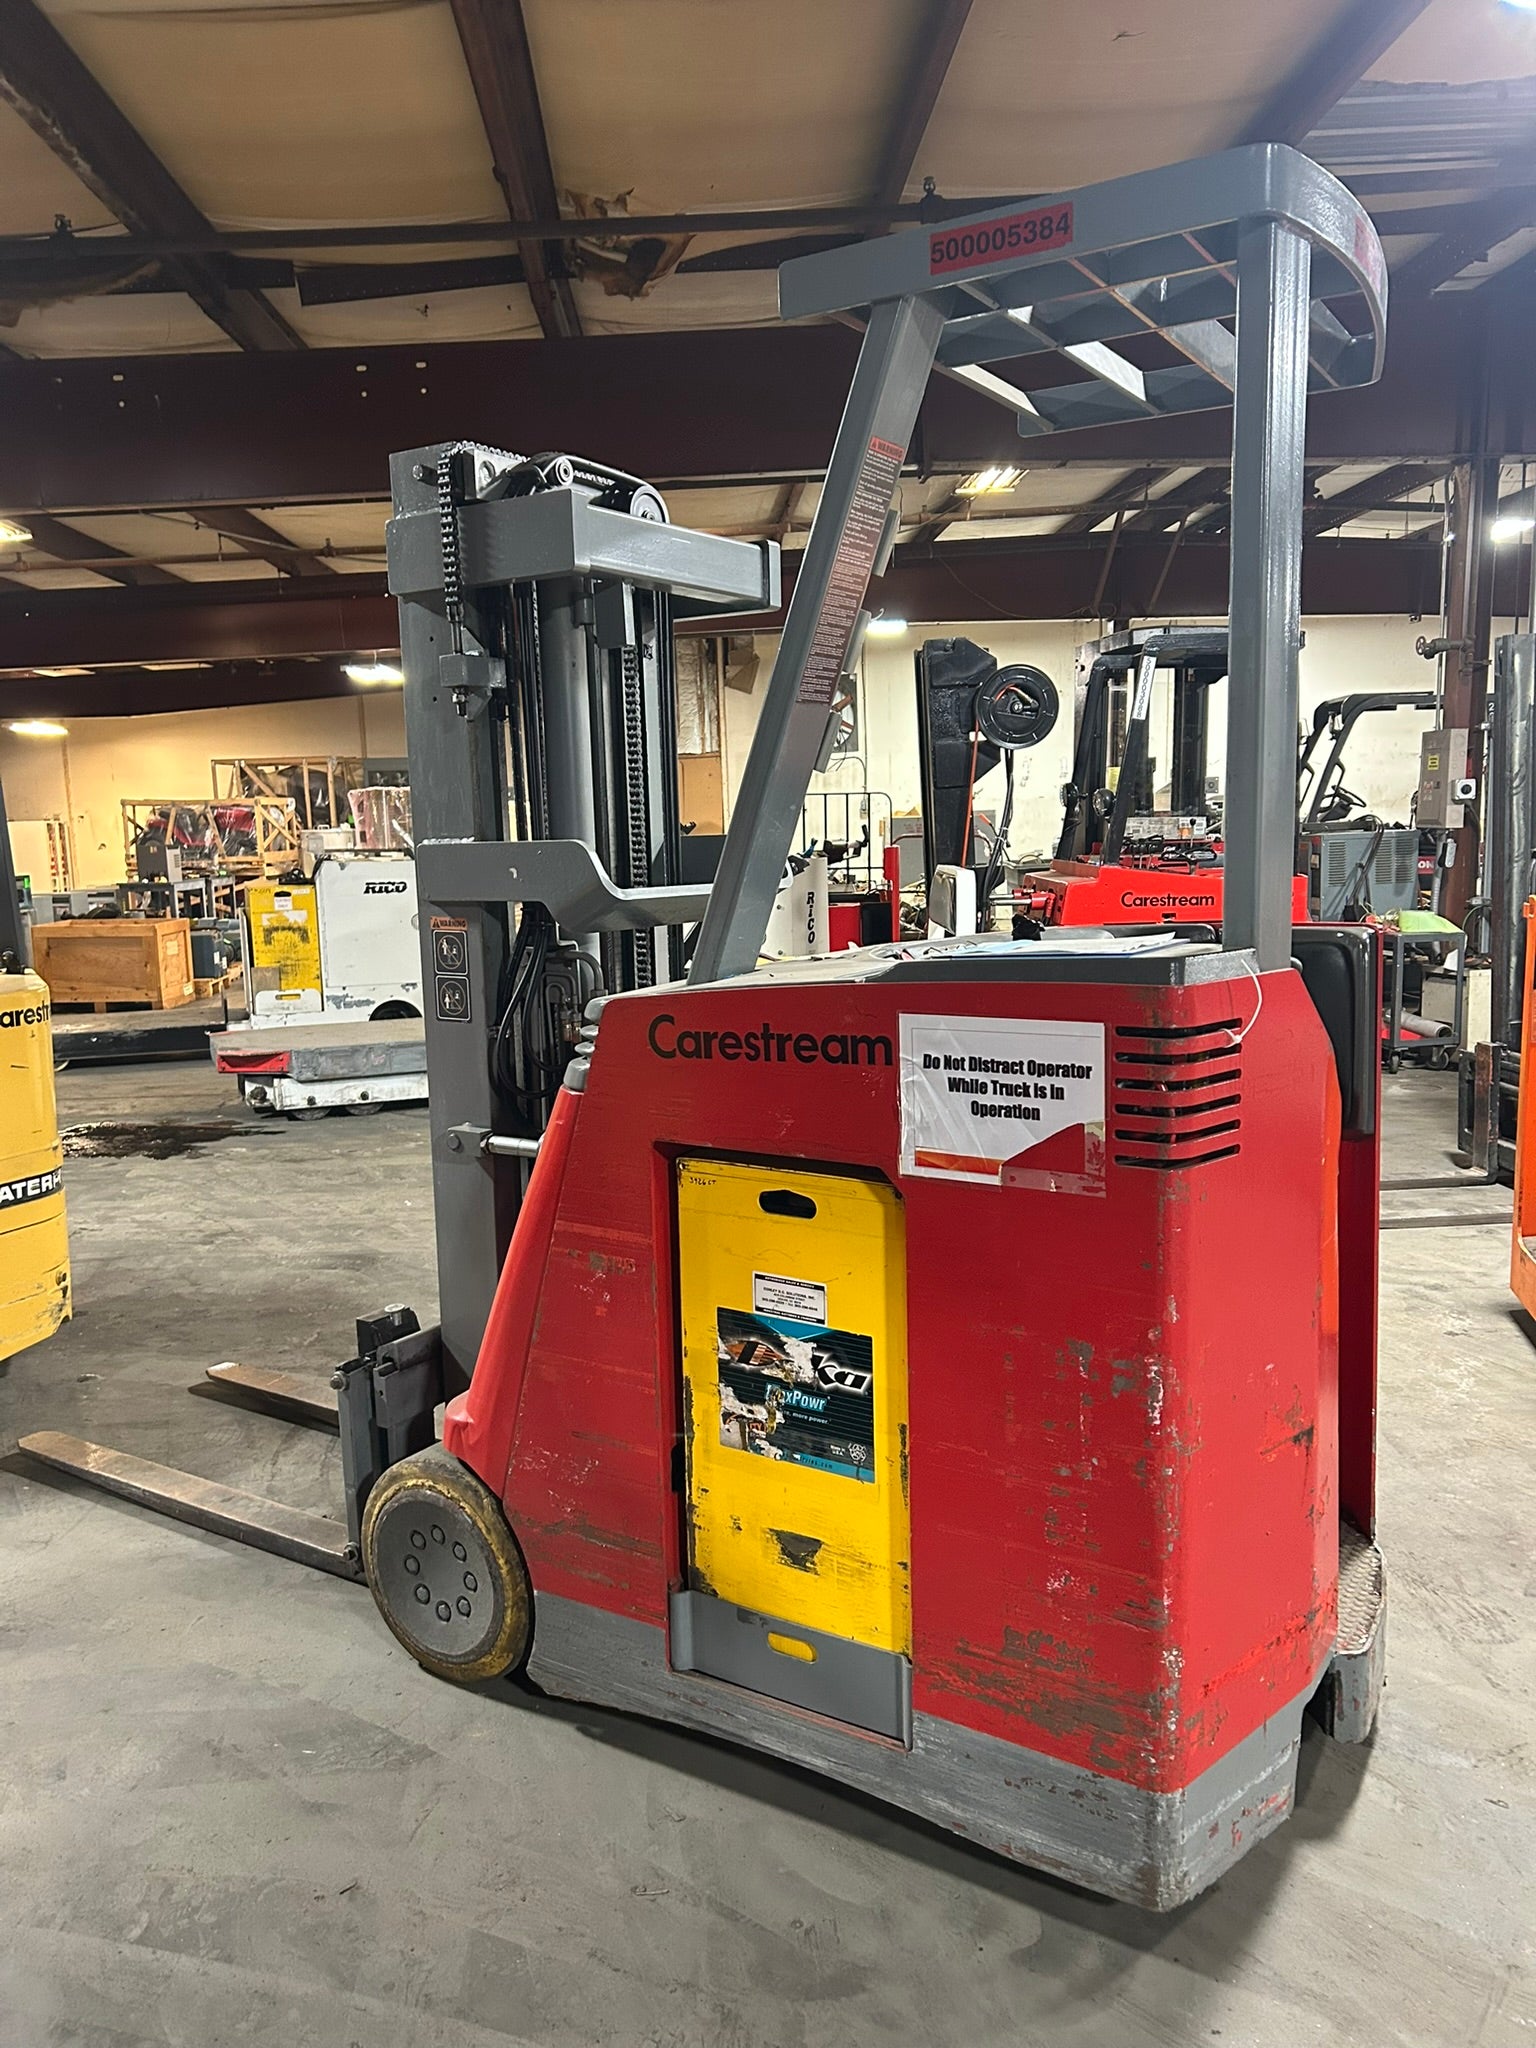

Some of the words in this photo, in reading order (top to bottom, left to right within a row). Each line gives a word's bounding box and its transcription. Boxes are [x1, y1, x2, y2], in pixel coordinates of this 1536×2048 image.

[930, 212, 1070, 263] 500005384
[363, 881, 408, 894] RICO
[1121, 891, 1215, 908] Carestream
[806, 891, 816, 944] RICO
[648, 1013, 894, 1066] Carestream
[923, 1053, 941, 1070] Do
[943, 1055, 967, 1072] Not
[968, 1056, 1025, 1076] Distract
[1027, 1059, 1093, 1080] Operator
[947, 1076, 988, 1095] While
[990, 1079, 1032, 1098] Truck
[970, 1100, 1041, 1121] Operation
